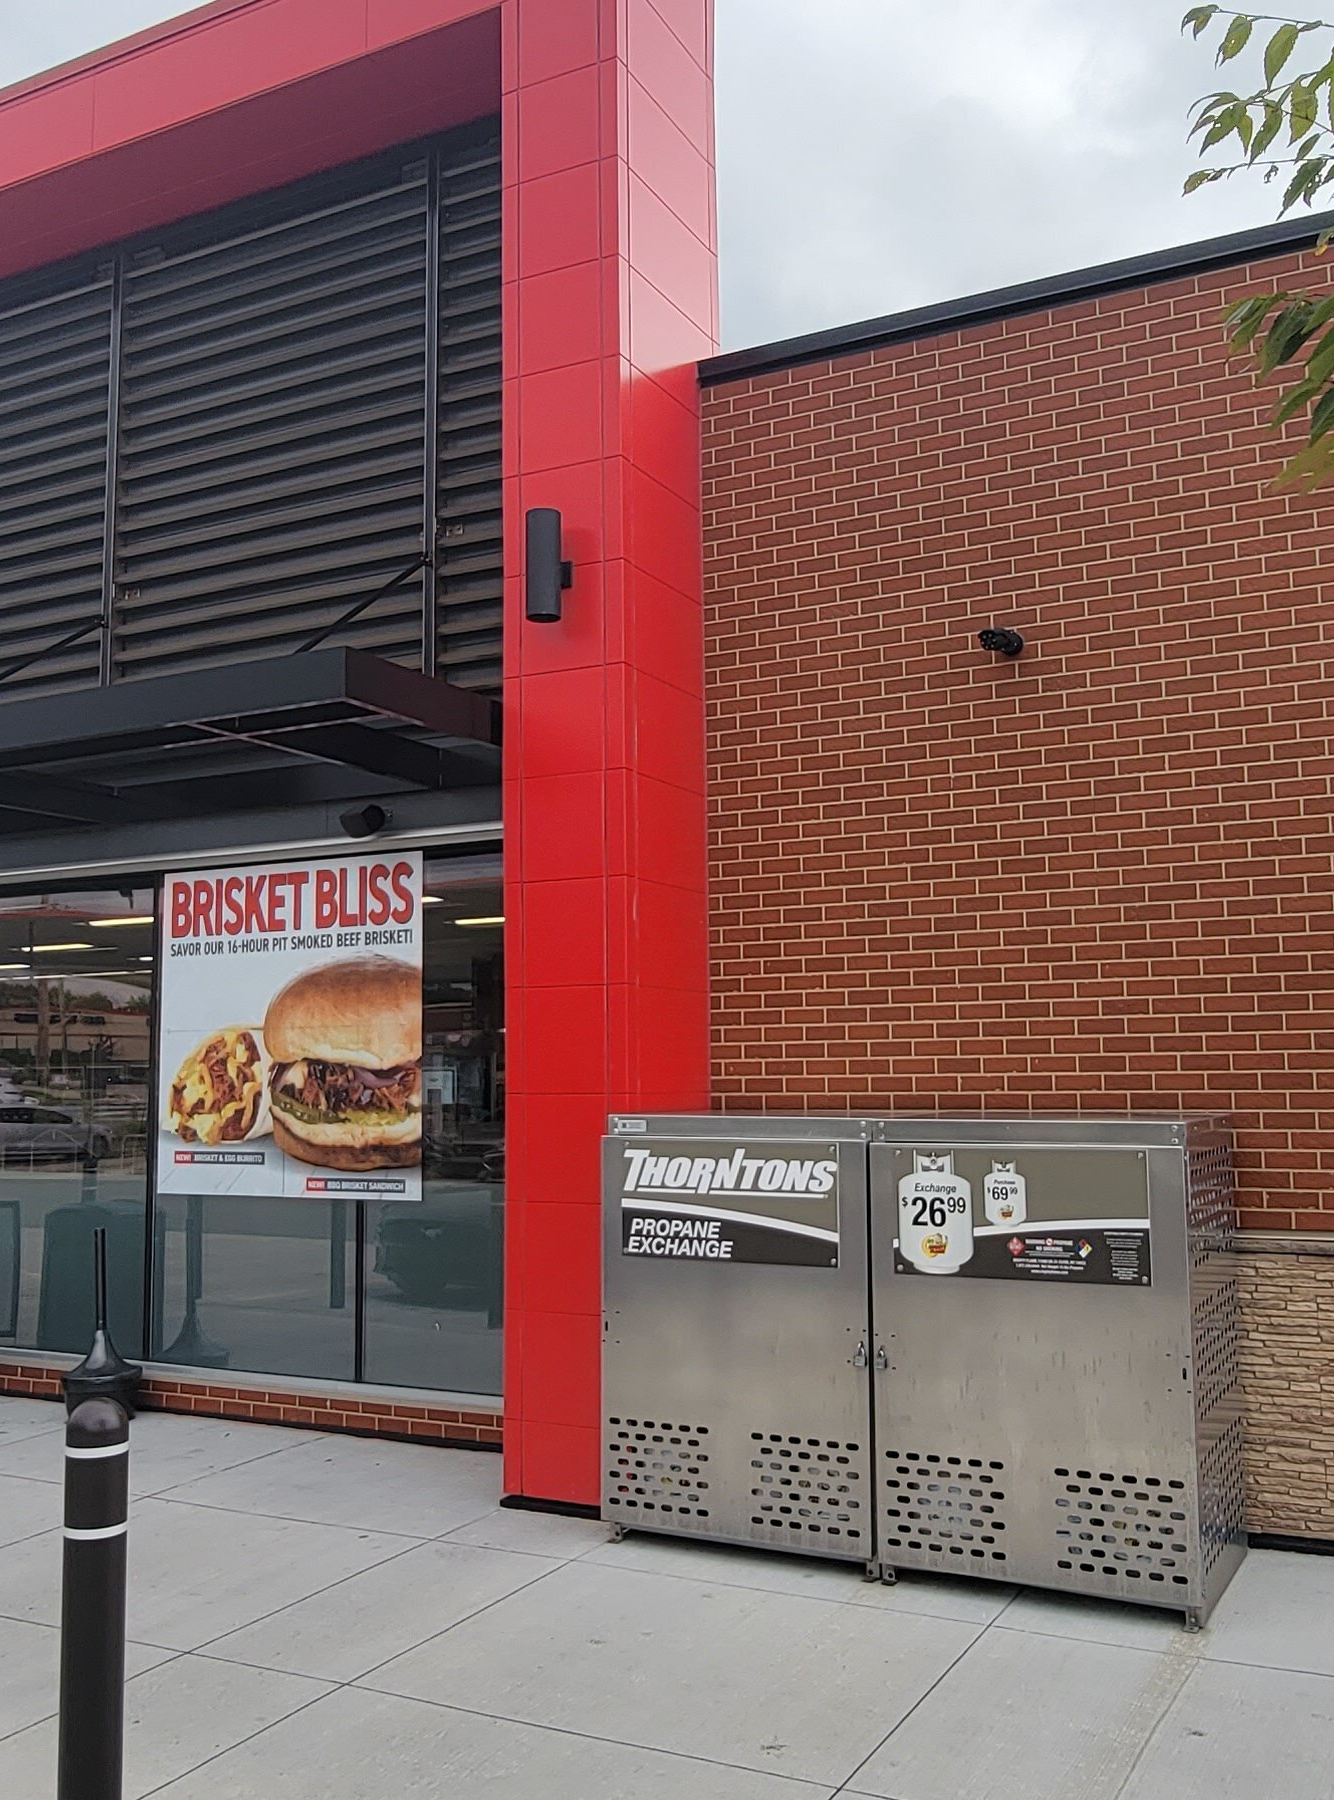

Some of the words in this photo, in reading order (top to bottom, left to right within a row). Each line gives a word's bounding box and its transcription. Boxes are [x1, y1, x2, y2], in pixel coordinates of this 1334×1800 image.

[171, 871, 309, 938] BRISKET
[315, 861, 414, 928] BLISS
[170, 943, 201, 957] SAVOR
[204, 941, 224, 955] OUR
[227, 938, 269, 954] 16-HOUR
[272, 937, 287, 951] PIT
[291, 934, 333, 950] SMOKED
[336, 932, 361, 947] BEEF
[364, 929, 413, 945] BRISKET!
[623, 1148, 837, 1195] THORNTONS
[368, 1182, 403, 1191] SANDWICH
[914, 1183, 957, 1194] Exchange
[631, 1218, 721, 1239] PROPANE
[627, 1237, 733, 1258] EXCHANGE
